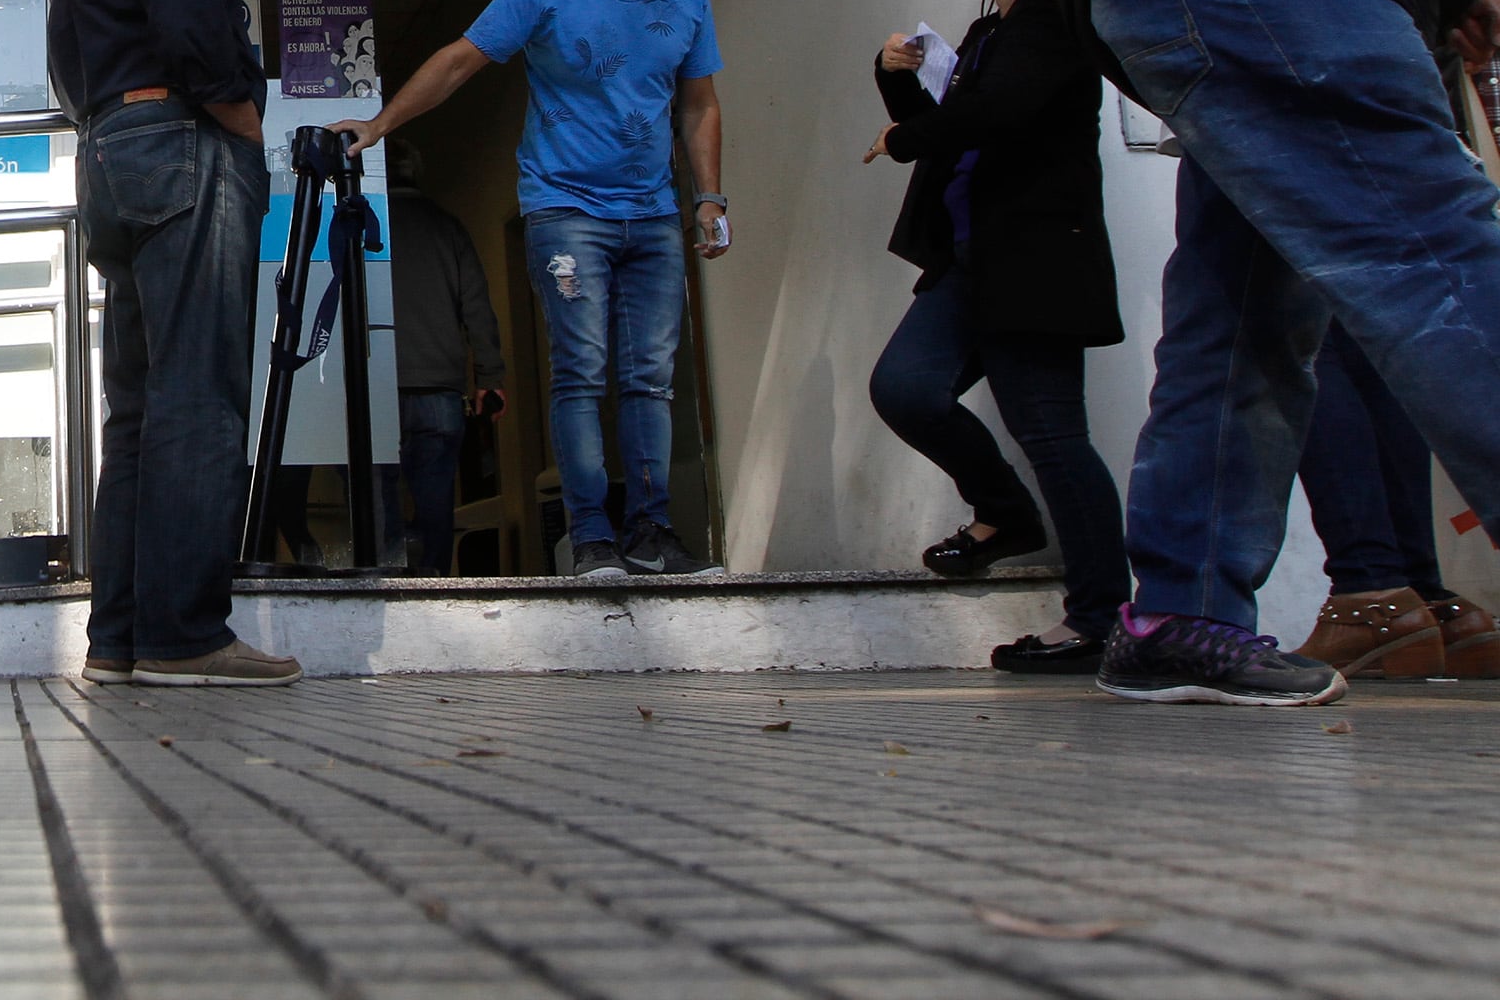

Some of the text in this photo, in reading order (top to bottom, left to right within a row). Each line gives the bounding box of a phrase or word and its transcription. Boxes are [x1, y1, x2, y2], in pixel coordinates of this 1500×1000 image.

[282, 6, 368, 16] CONTRA LAS VIOLENCIAS
[283, 18, 293, 27] DE
[287, 43, 297, 53] ES
[290, 84, 326, 94] ANSES
[313, 328, 330, 356] ANS
